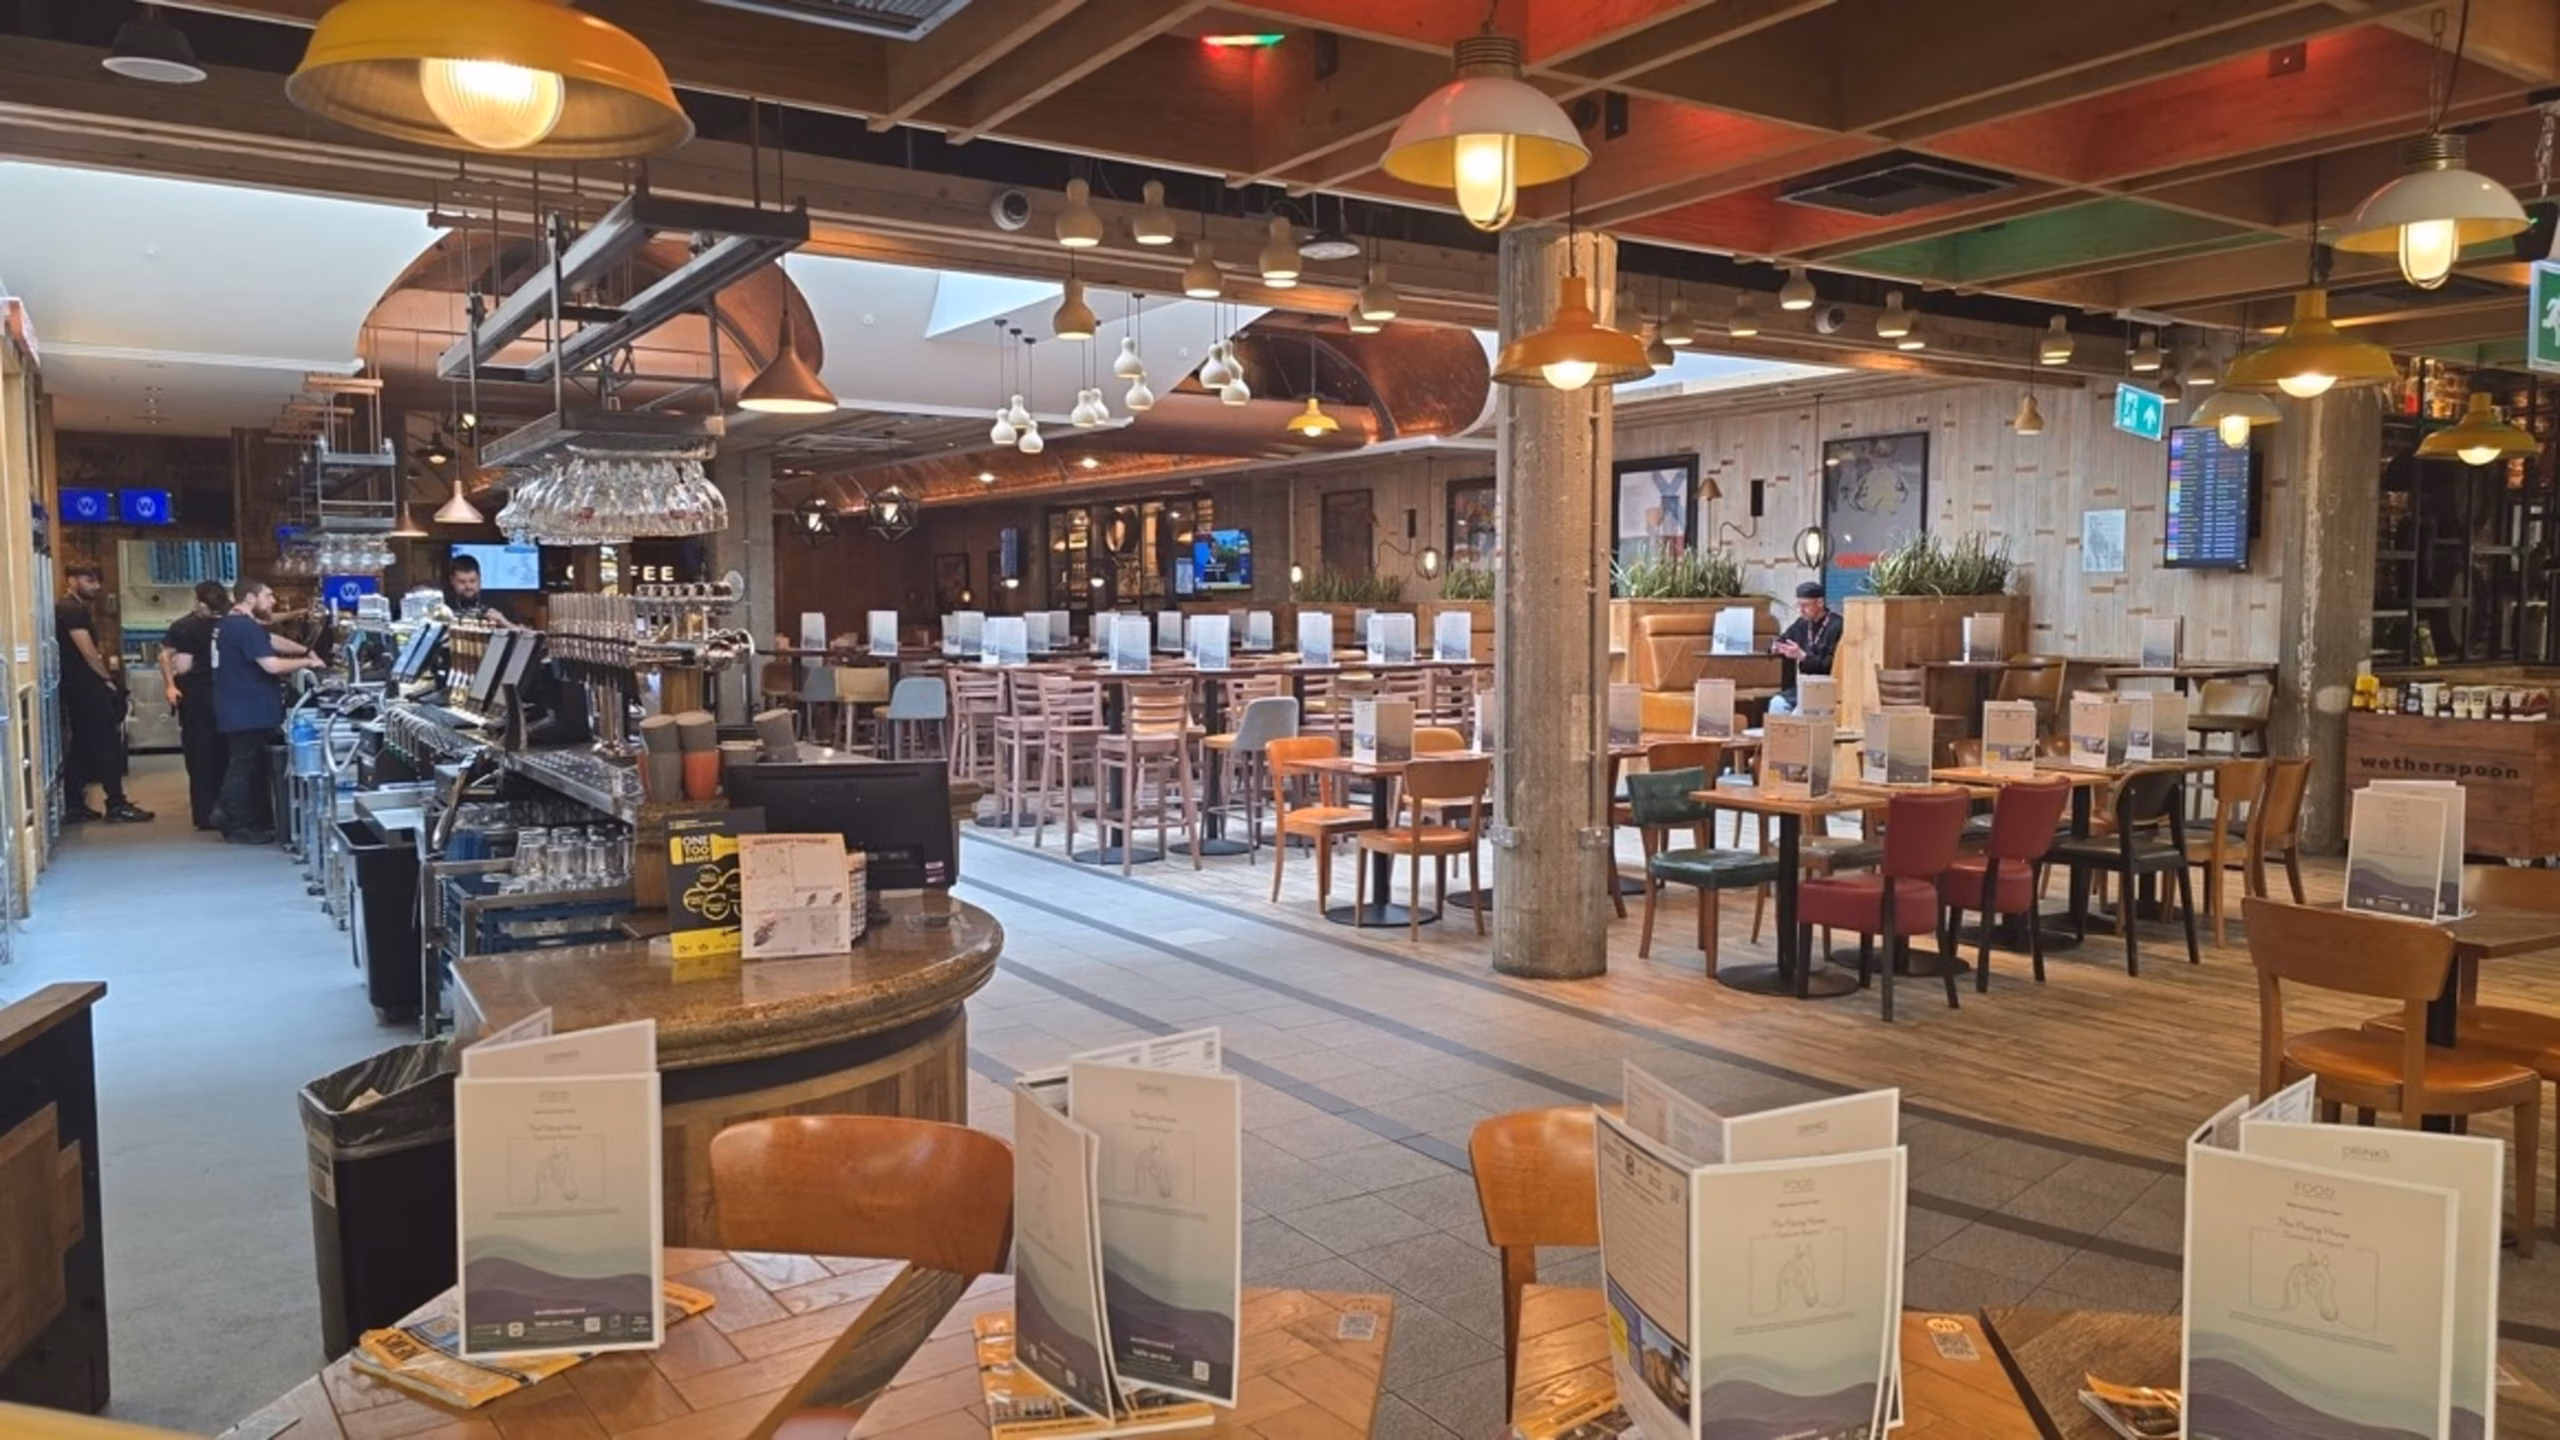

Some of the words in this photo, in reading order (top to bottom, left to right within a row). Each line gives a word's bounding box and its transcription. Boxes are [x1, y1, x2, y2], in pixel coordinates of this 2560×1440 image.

[2360, 757, 2519, 779] wetherspoon
[683, 835, 708, 846] ONE
[683, 845, 709, 855] TOO
[2342, 1145, 2390, 1161] DRINKS
[2294, 1180, 2336, 1199] FOOD
